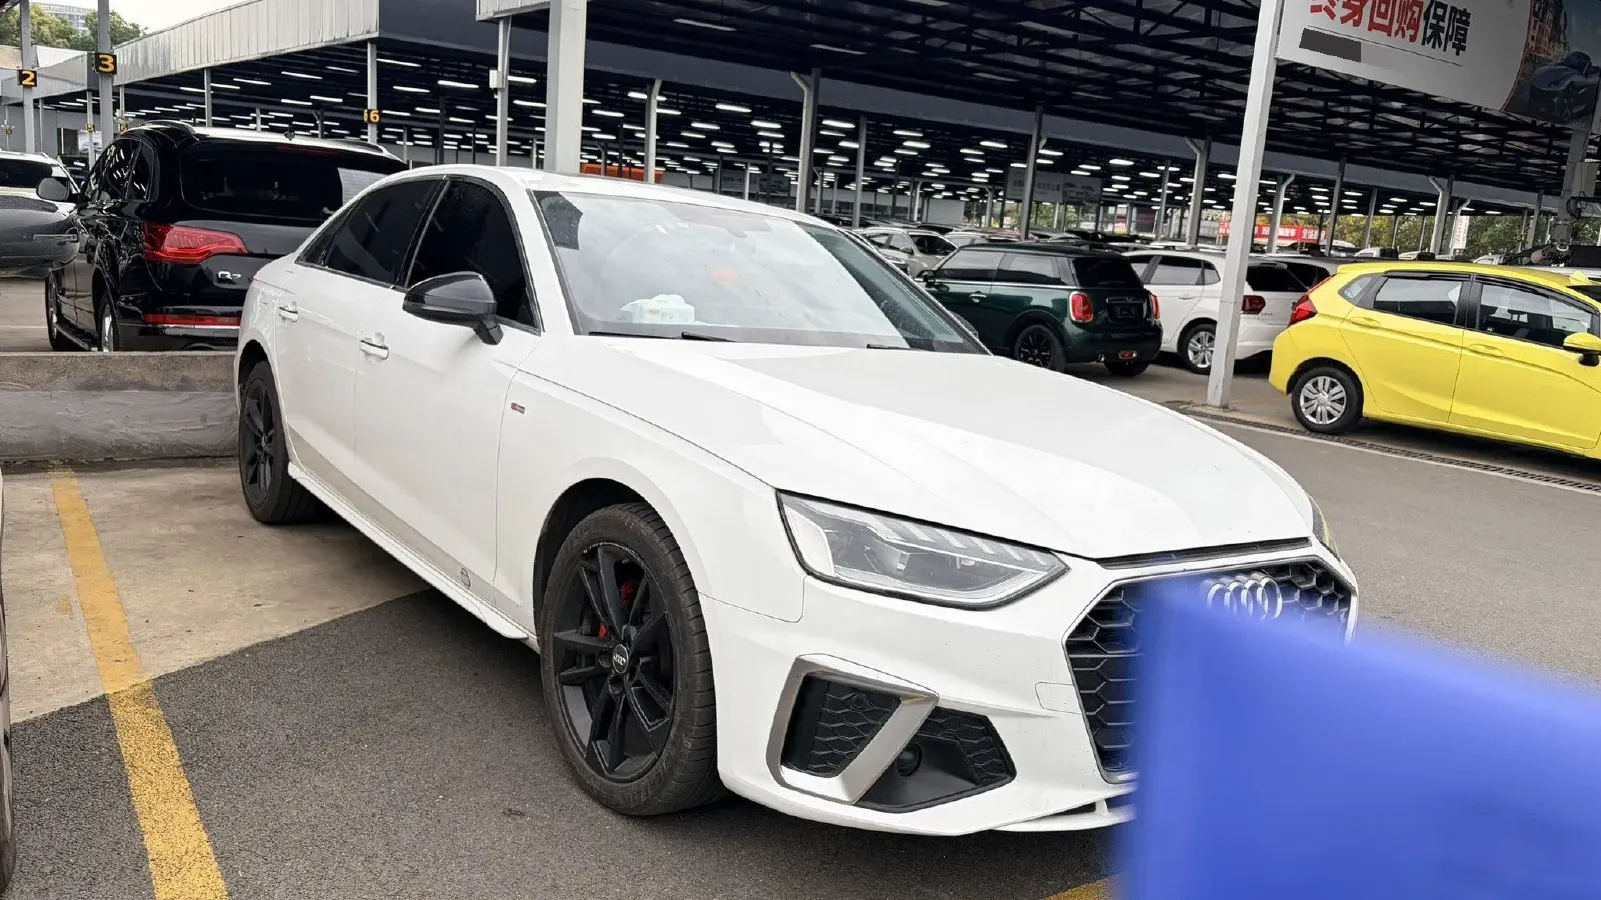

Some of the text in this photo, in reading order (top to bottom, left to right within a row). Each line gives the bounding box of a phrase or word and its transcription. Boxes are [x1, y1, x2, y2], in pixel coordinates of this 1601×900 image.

[98, 54, 115, 73] 3
[22, 71, 35, 86] 2
[370, 110, 379, 122] 6
[218, 271, 242, 282] Q7
